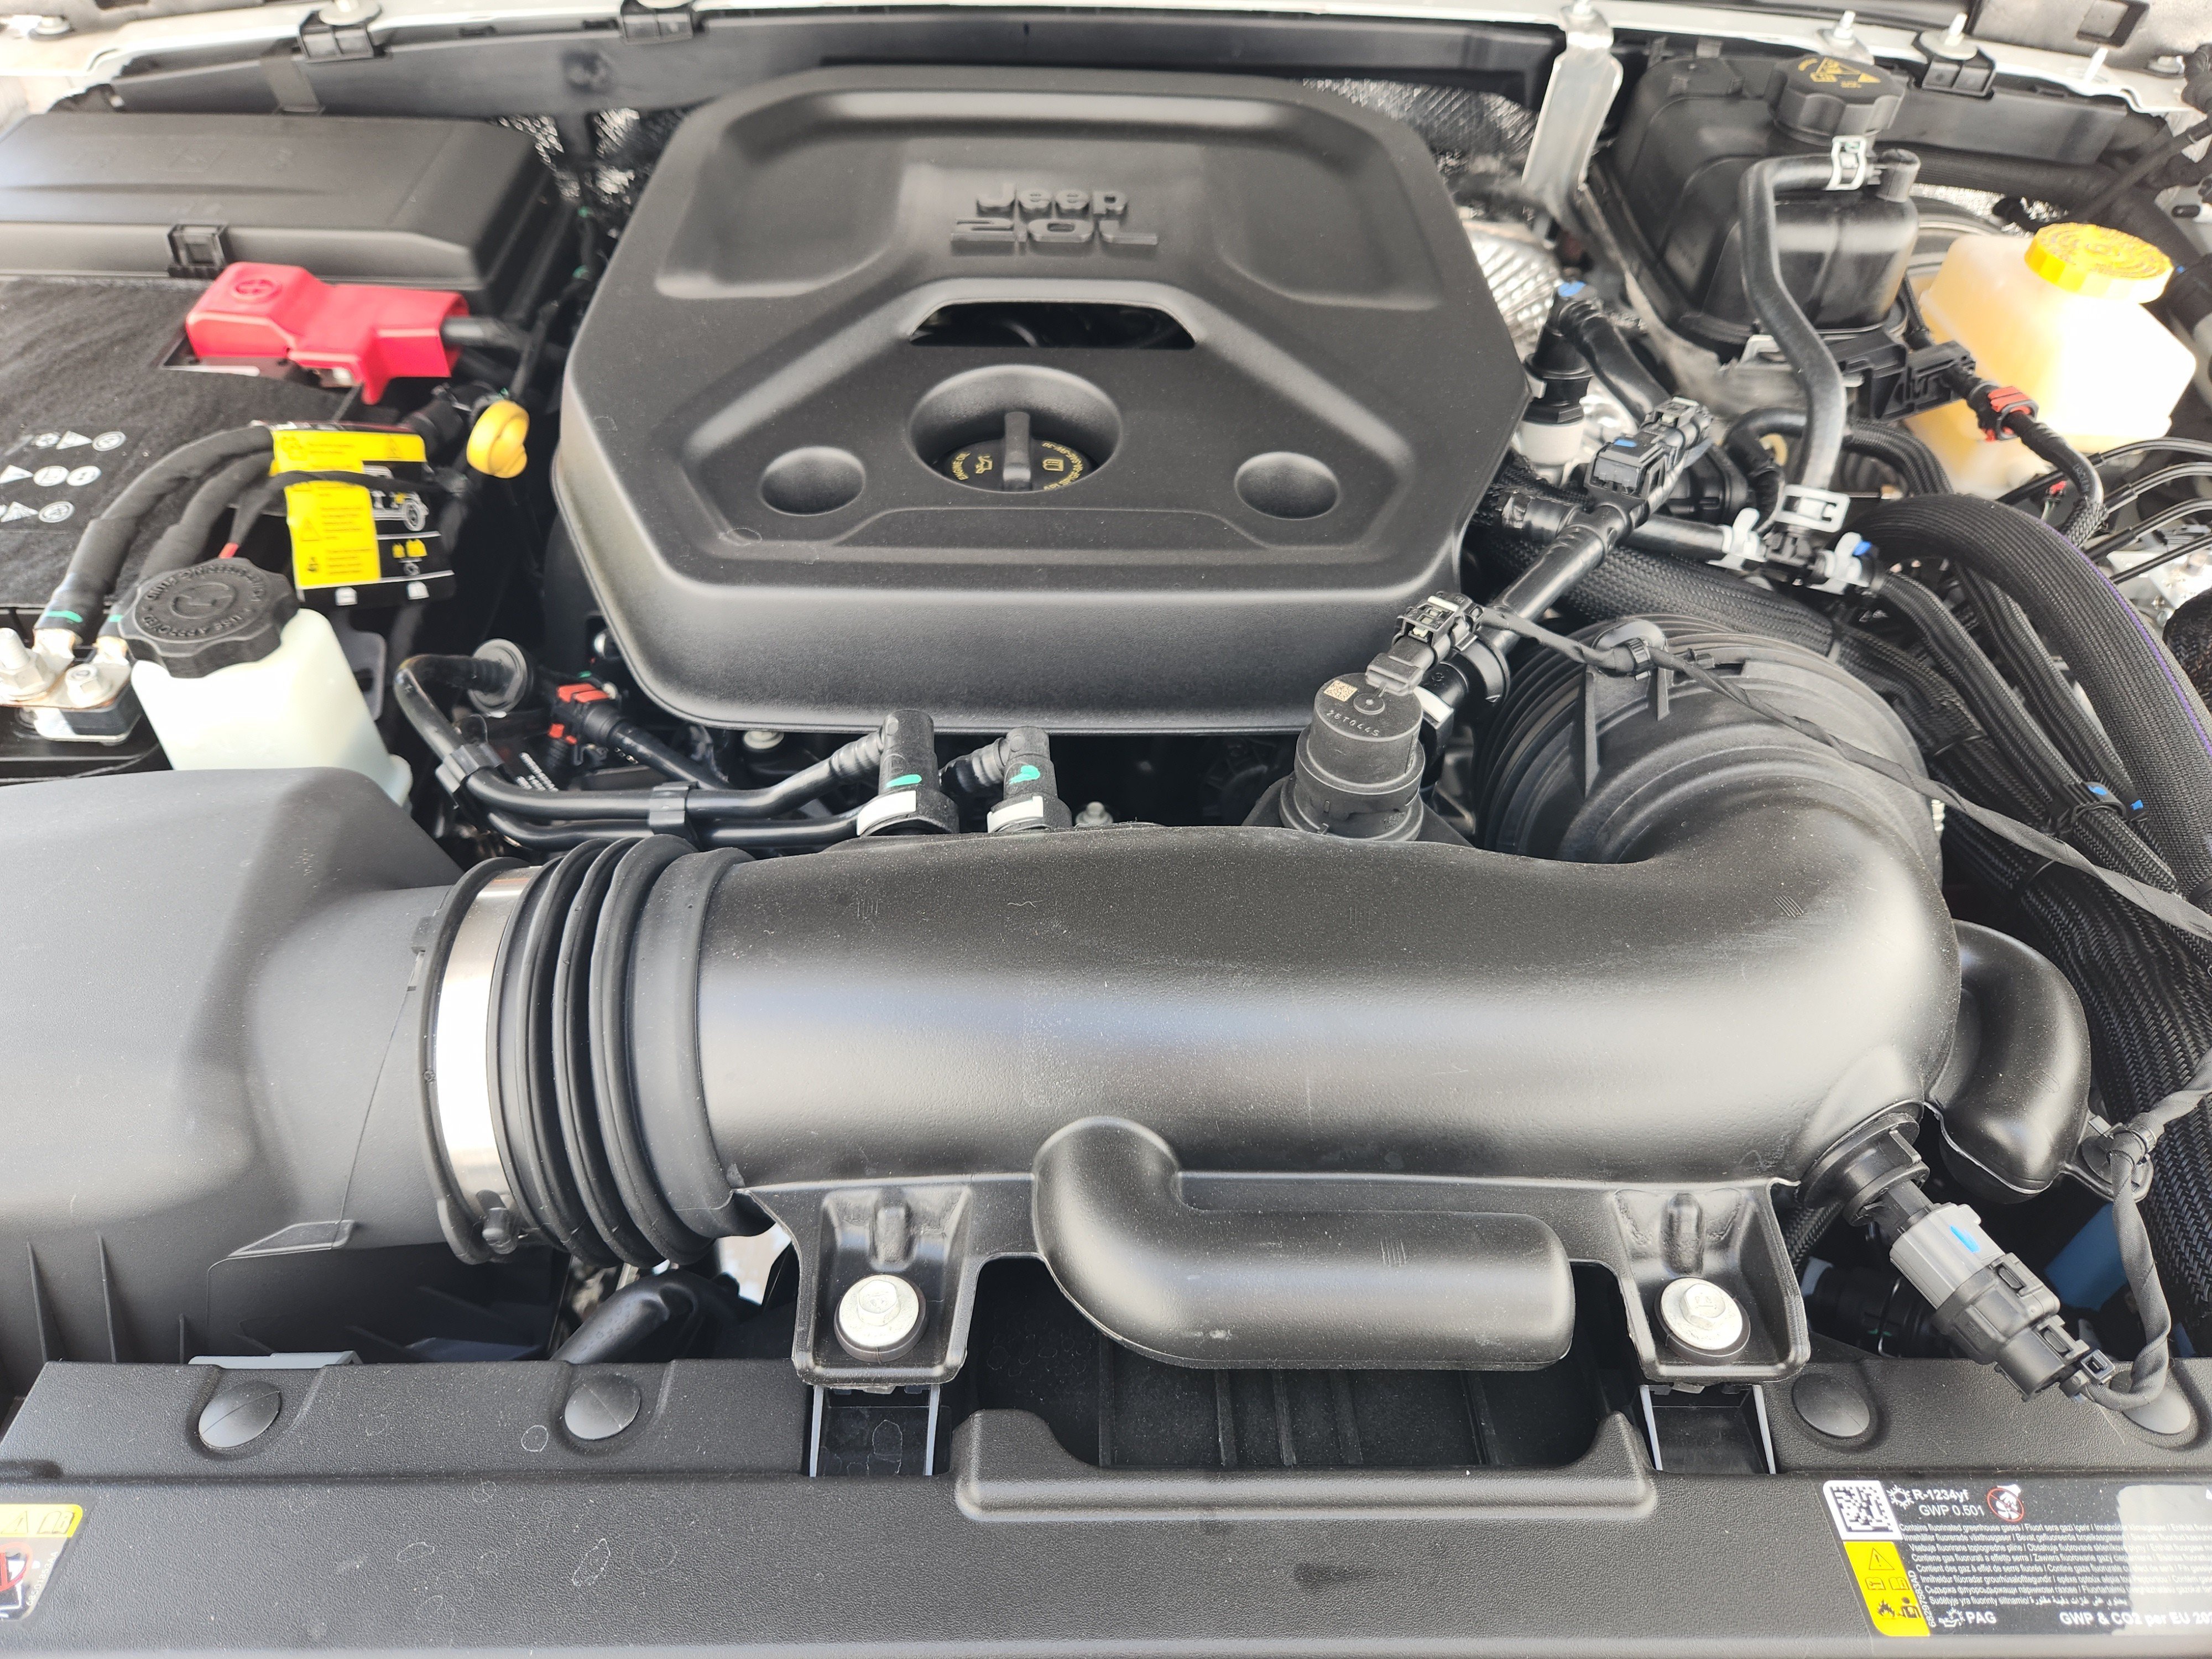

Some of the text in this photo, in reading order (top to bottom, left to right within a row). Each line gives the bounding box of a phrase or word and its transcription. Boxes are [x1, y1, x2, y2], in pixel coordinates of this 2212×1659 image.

[975, 182, 1128, 216] Jeep
[950, 218, 1158, 245] 2.0L
[952, 452, 971, 480] ENGINE OIL
[1912, 1489, 1970, 1503] R-1234yf
[1919, 1505, 1985, 1516] GWP 0.501
[1899, 1523, 1928, 1532] Contains
[1928, 1523, 1962, 1532] fluorinated
[1964, 1524, 2000, 1533] greenhouse
[2001, 1525, 2021, 1533] gases
[1911, 1553, 1942, 1562] Contiene
[1942, 1555, 1954, 1563] gas
[1916, 1564, 1944, 1573] Contient
[1945, 1564, 1957, 1573] des
[1908, 1570, 1937, 1627] 68297583AD
[1965, 1611, 1997, 1624] PAG
[2059, 1611, 2094, 1625] GWP
[2097, 1611, 2110, 1625] &
[2111, 1611, 2143, 1625] CO2
[2144, 1614, 2167, 1627] per
[2169, 1611, 2191, 1625] EU
